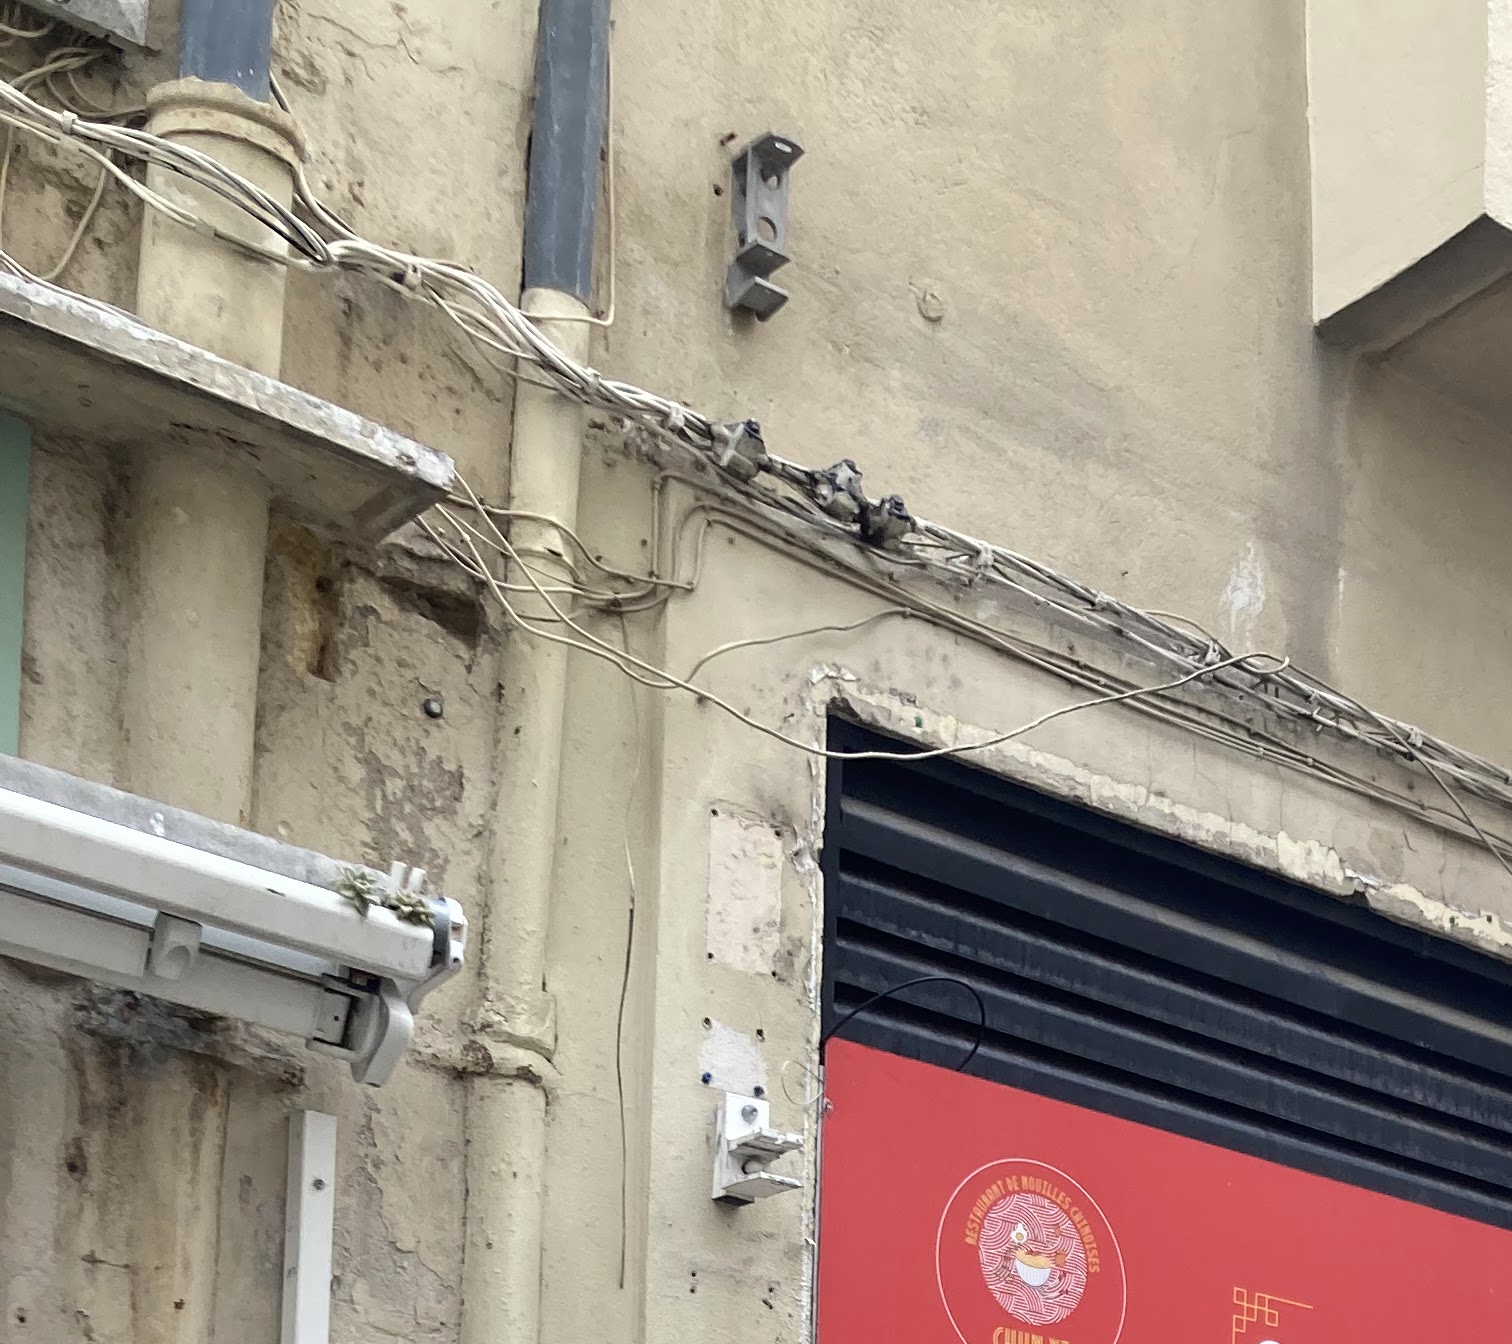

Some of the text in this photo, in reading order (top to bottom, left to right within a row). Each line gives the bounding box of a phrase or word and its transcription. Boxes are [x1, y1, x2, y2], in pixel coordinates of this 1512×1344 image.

[964, 1175, 1101, 1274] RESTAURANT DE NOUILLES CHINOISES
